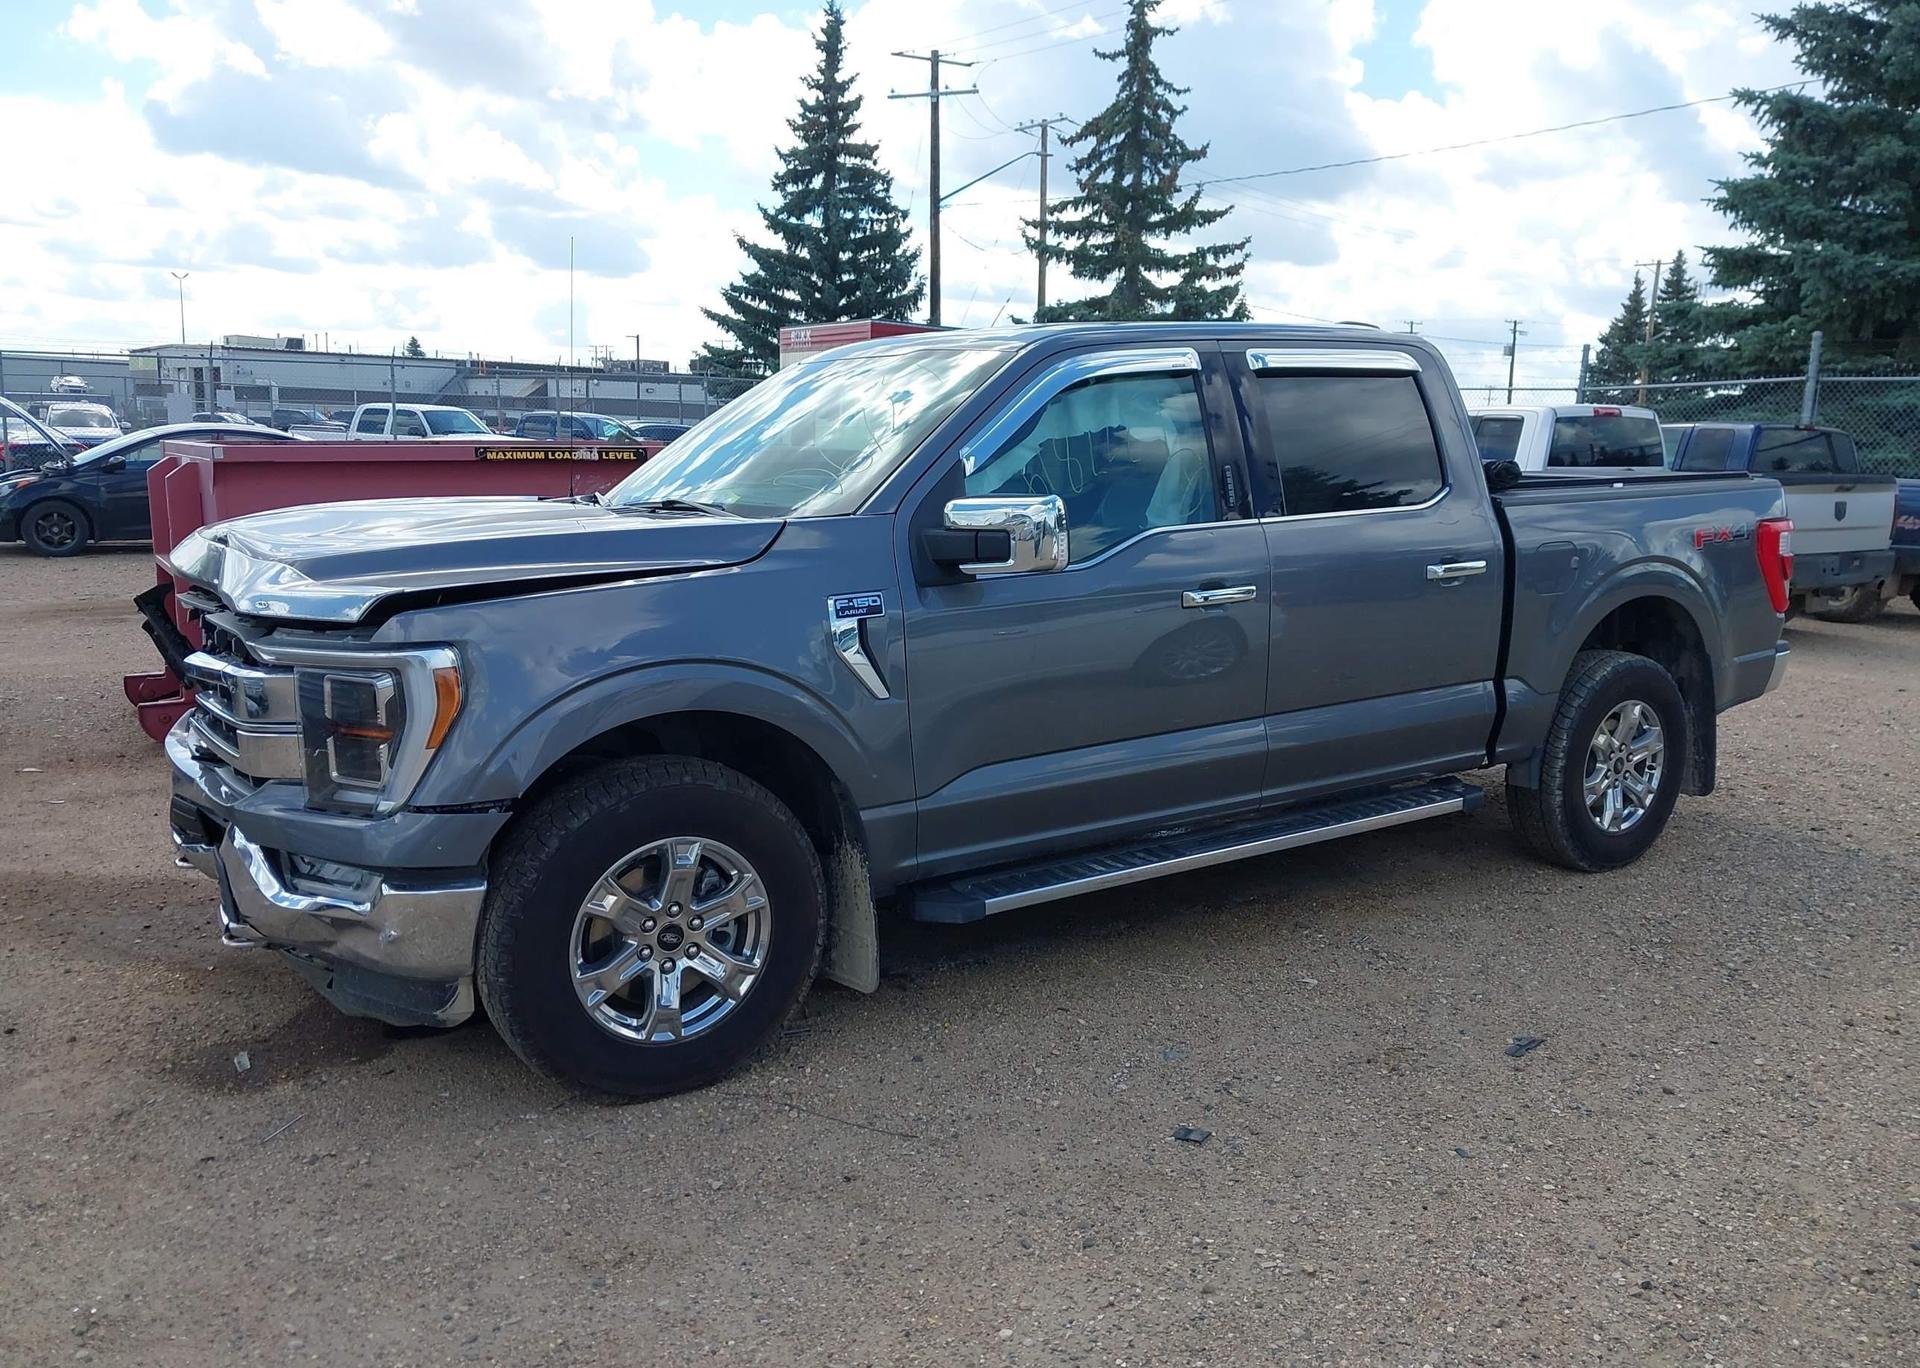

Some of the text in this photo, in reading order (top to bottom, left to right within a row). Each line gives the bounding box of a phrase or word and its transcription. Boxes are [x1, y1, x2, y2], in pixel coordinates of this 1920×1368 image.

[486, 450, 545, 461] MAXIMUM
[602, 450, 637, 461] LEVEL
[1695, 523, 1747, 550] FX4
[835, 597, 881, 609] F-150
[839, 608, 867, 616] LARIAT
